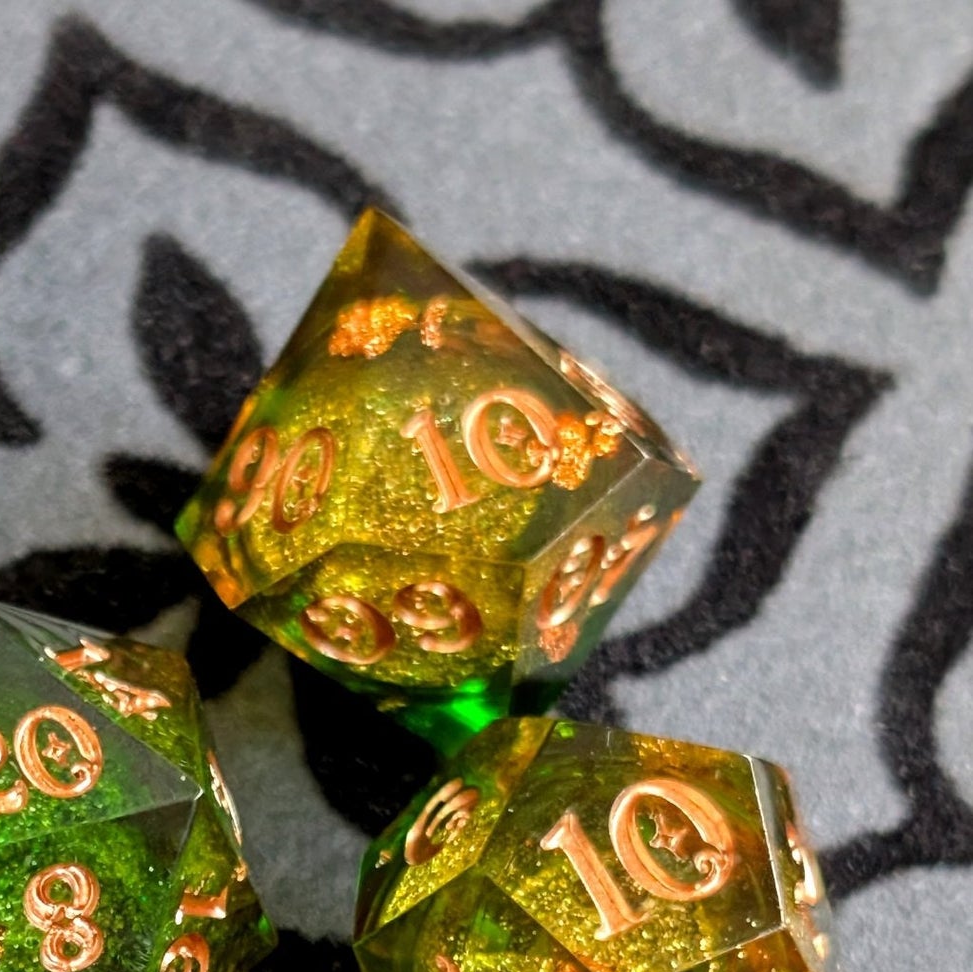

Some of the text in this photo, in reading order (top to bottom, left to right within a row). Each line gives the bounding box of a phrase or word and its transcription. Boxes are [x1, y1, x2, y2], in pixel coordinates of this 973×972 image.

[215, 427, 335, 537] 90
[400, 387, 559, 513] 10
[540, 778, 735, 941] 10
